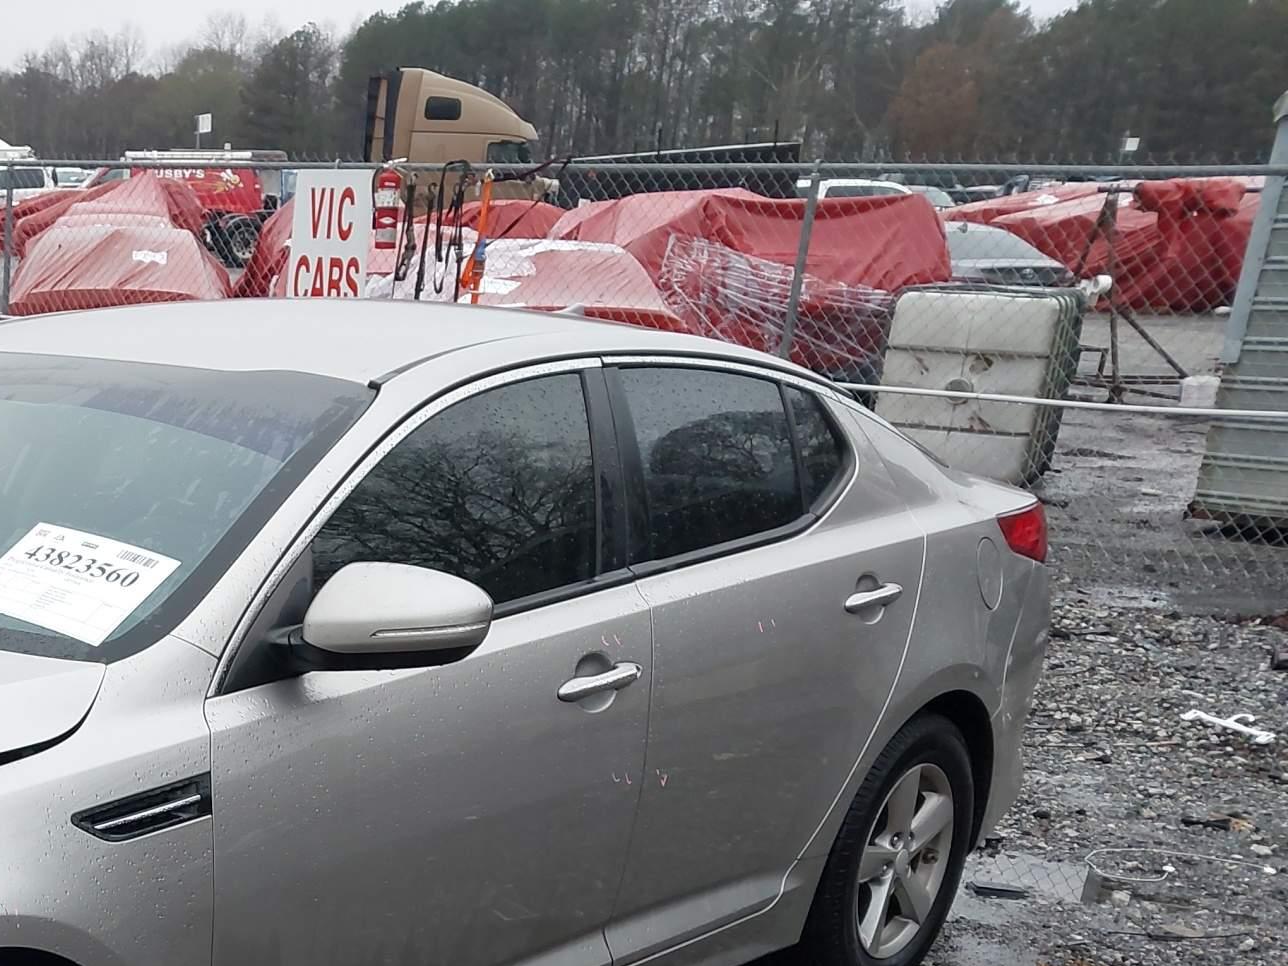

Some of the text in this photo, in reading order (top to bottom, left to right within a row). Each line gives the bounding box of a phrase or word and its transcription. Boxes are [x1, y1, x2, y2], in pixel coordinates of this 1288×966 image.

[311, 187, 355, 241] VIC
[294, 255, 360, 297] CARS
[24, 545, 140, 588] 43823560
